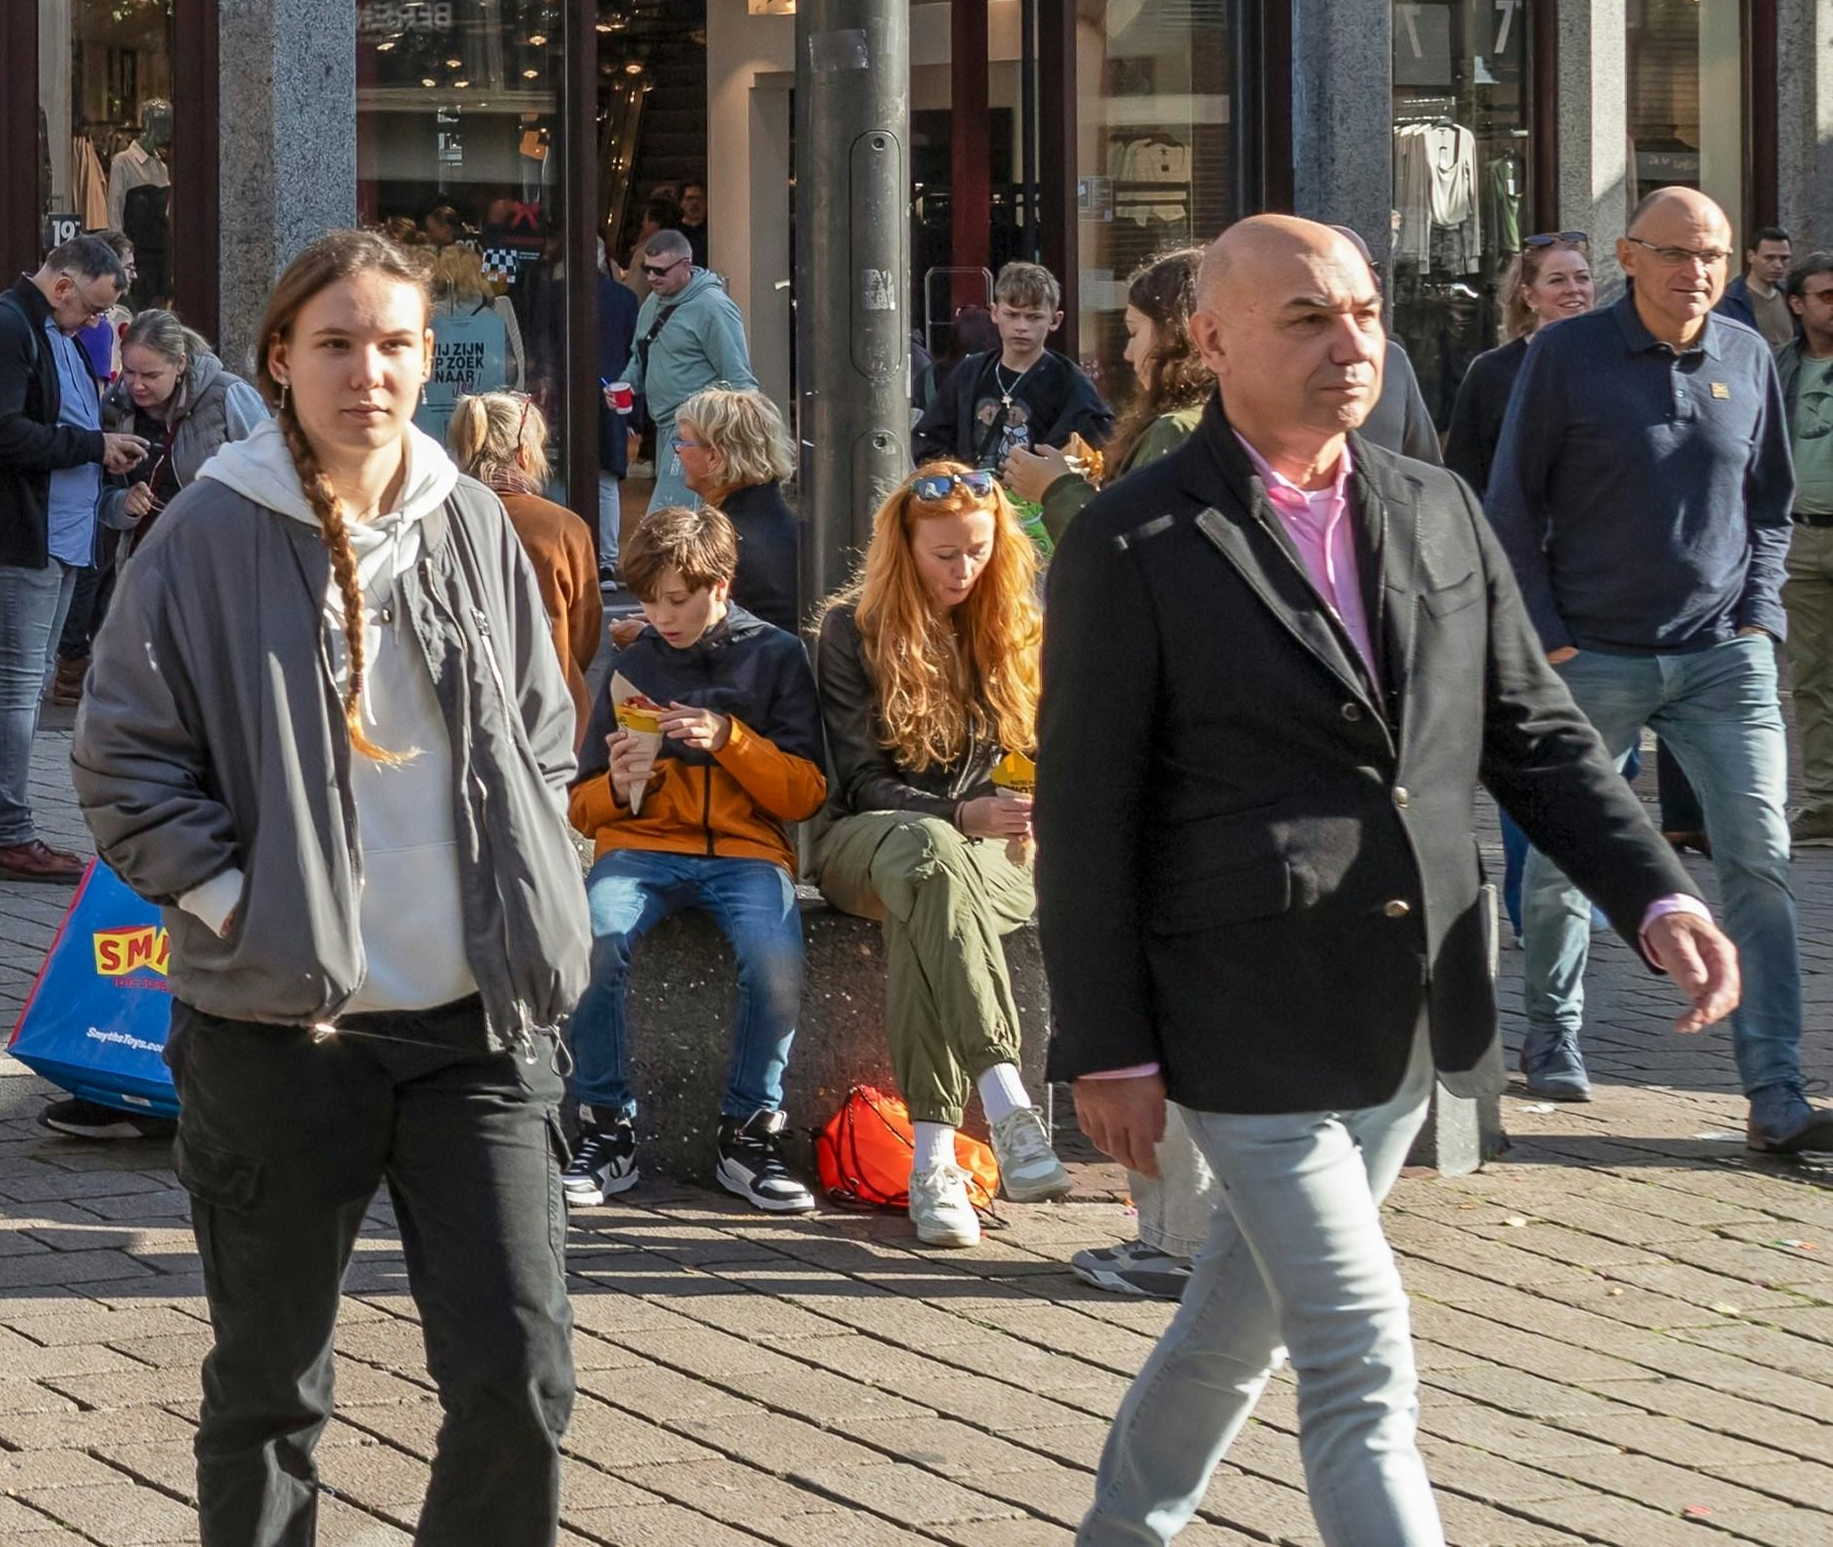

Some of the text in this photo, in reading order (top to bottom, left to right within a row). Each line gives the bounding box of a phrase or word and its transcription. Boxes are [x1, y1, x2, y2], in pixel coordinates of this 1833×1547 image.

[453, 342, 485, 357] ZIJN
[446, 356, 485, 370] ZOEK
[435, 370, 475, 384] NAAR
